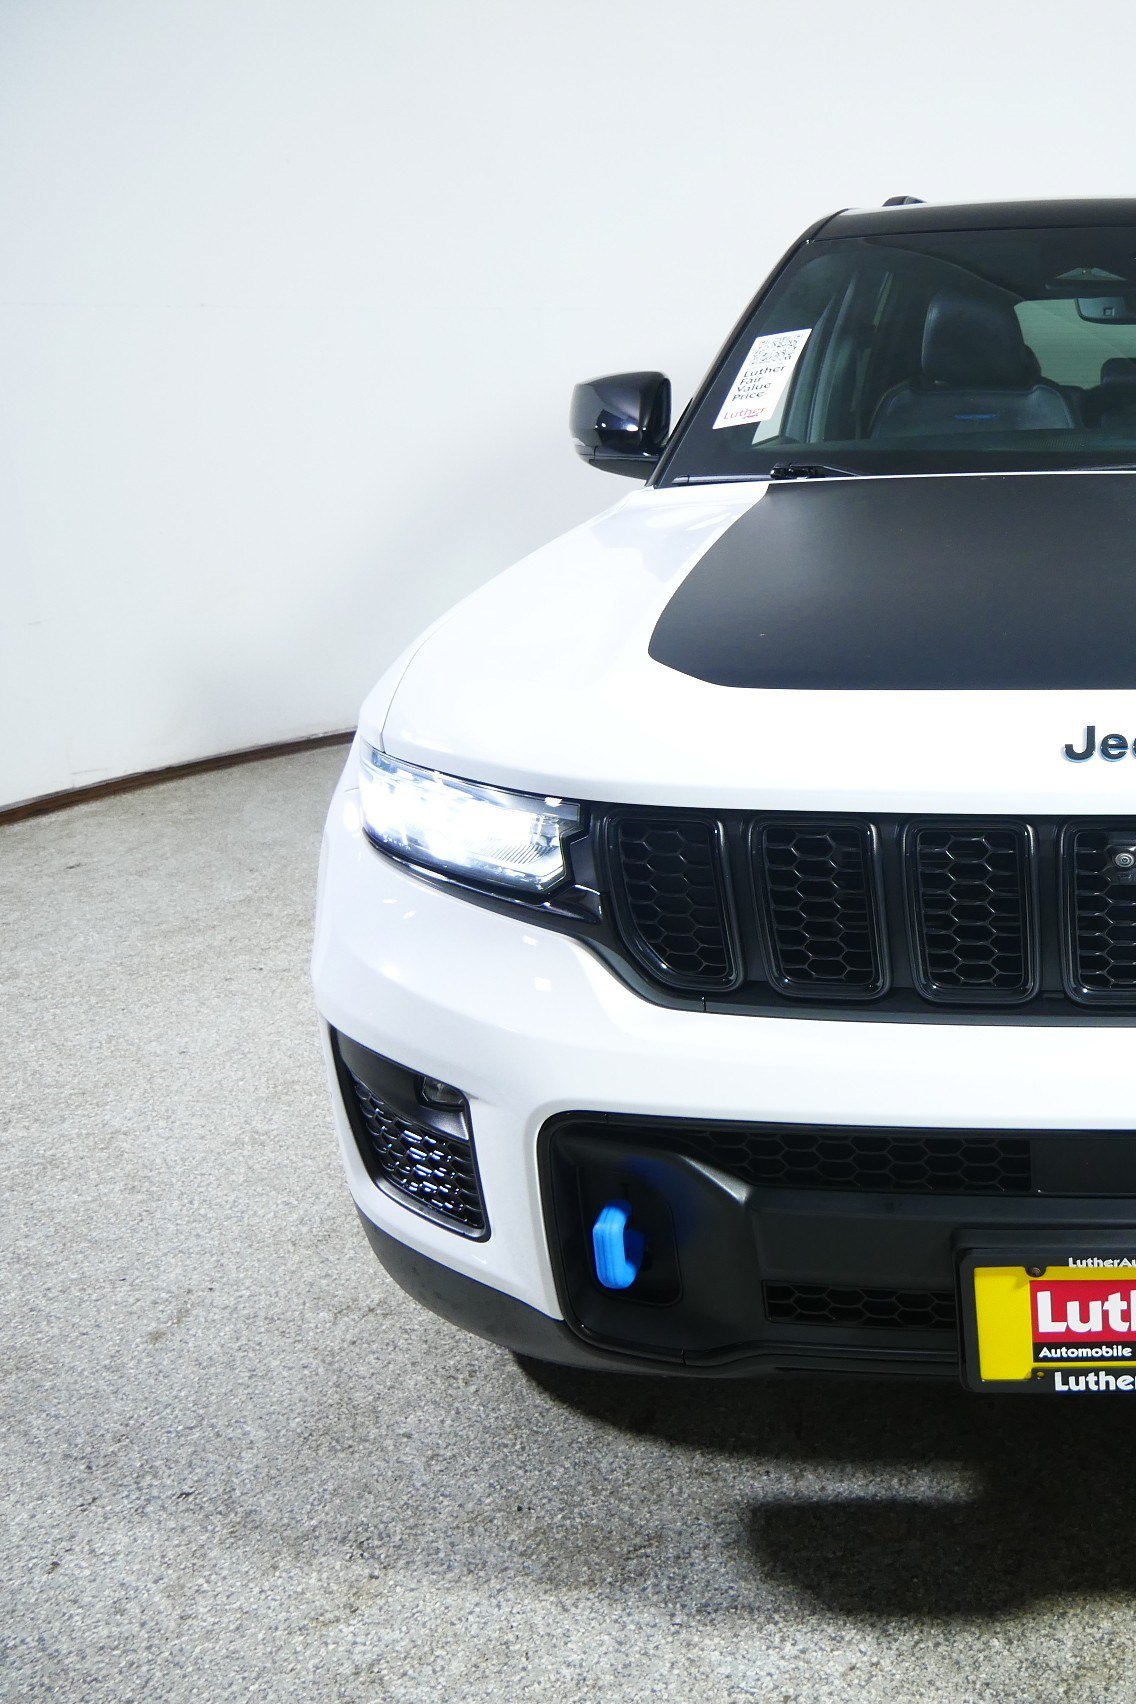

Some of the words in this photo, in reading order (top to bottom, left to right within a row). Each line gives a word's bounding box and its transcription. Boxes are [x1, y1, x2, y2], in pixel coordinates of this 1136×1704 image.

[743, 366, 785, 377] Luther
[739, 377, 762, 385] Fair
[737, 383, 771, 392] Value
[731, 392, 764, 401] Price
[1038, 1345, 1132, 1358] Automobile
